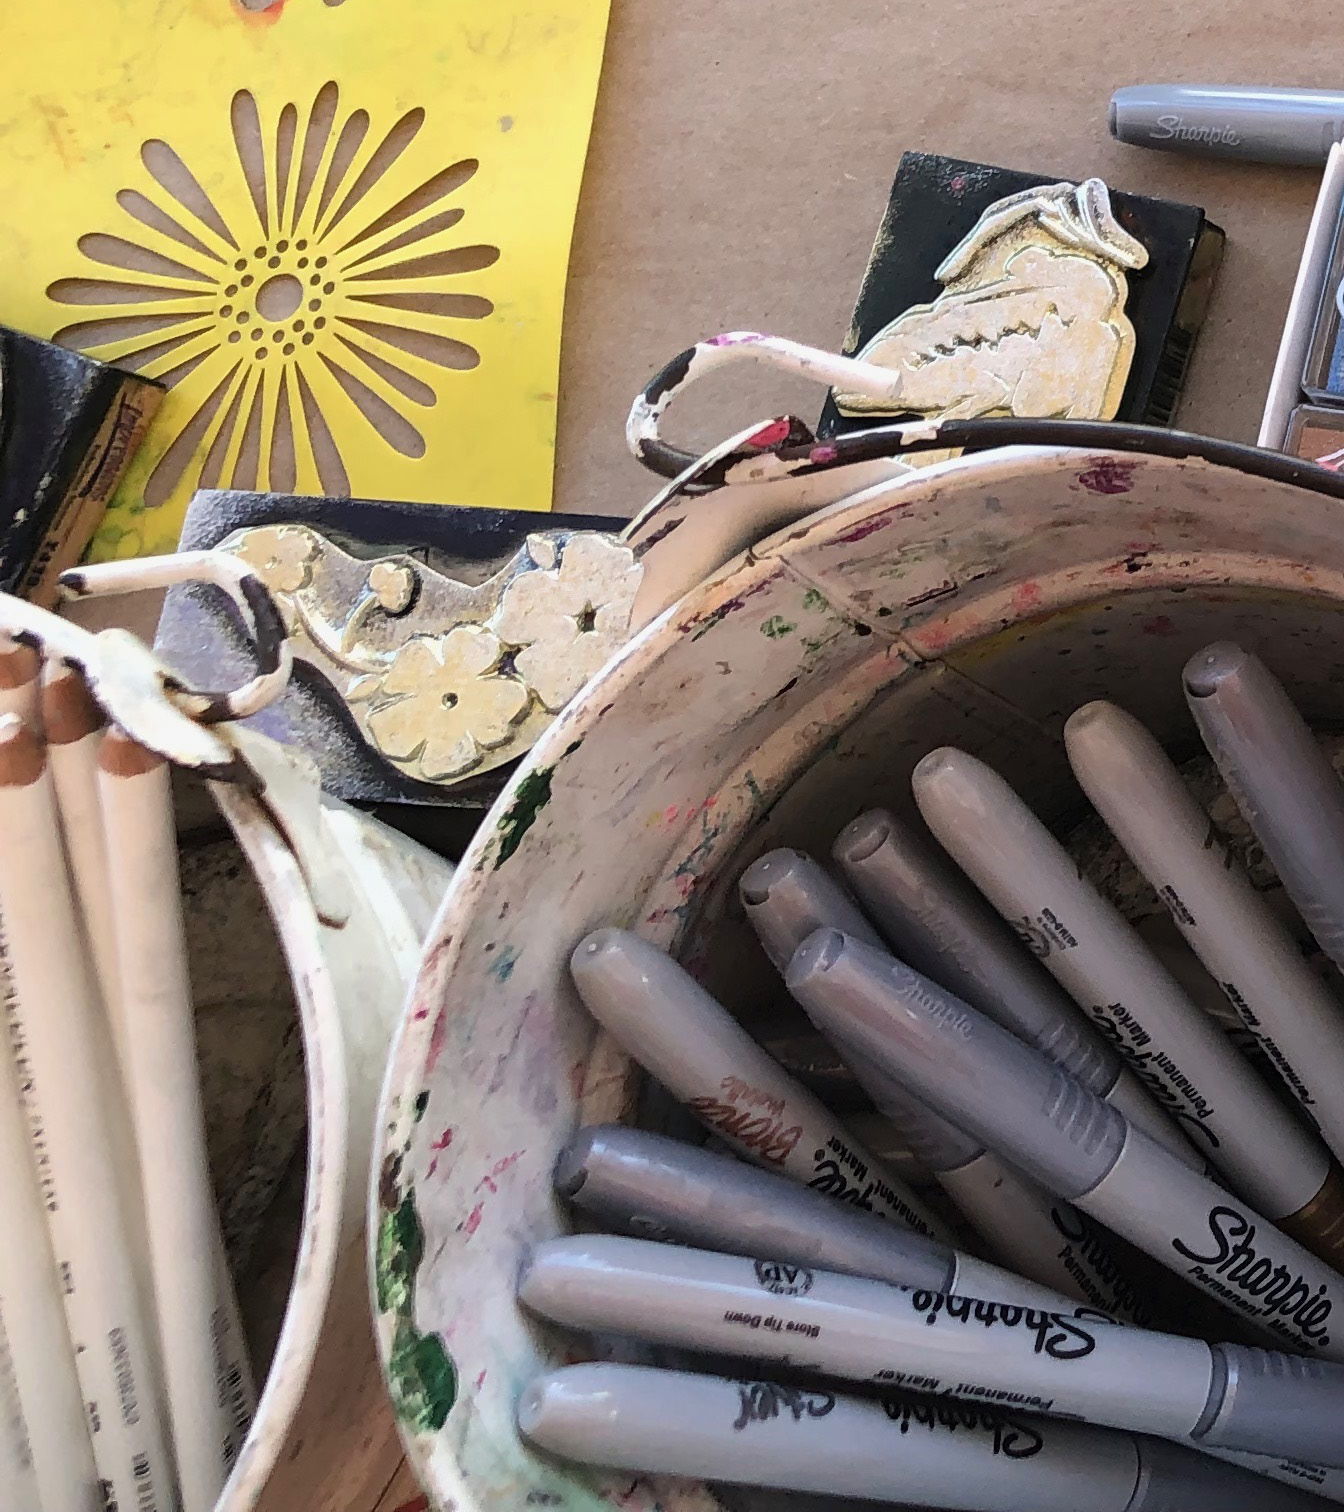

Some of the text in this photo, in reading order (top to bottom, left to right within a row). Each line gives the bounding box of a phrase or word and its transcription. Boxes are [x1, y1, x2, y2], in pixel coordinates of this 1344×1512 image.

[1108, 1002, 1215, 1120] Permanent Marker
[827, 1135, 869, 1183] Marker
[1171, 1205, 1333, 1347] Sharpie
